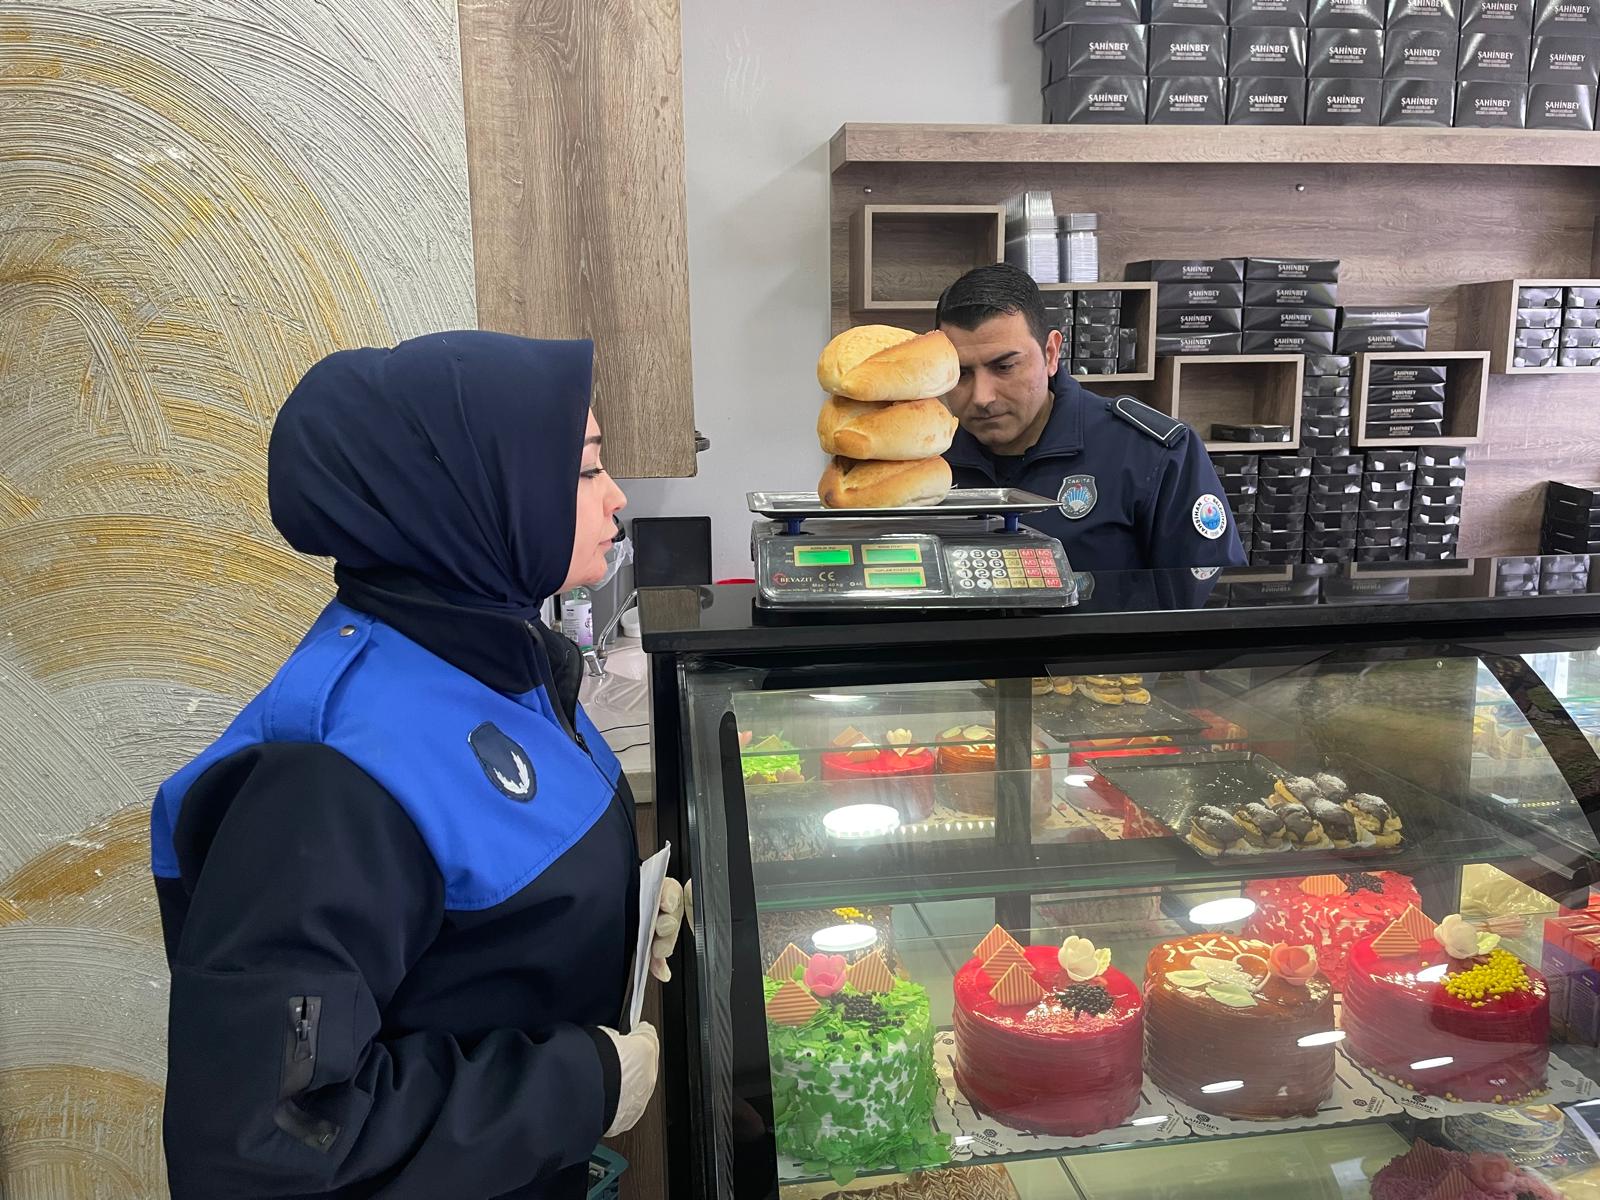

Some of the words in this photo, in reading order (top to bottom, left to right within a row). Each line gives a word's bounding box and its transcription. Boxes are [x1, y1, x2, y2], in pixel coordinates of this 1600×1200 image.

[1481, 1, 1519, 12] ŞAHİNBEY
[1554, 3, 1591, 14] ŞAHİNBEY
[1089, 40, 1129, 52] ŞAHİNBEY
[1170, 42, 1209, 53] ŞAHİNBEY
[1250, 43, 1289, 54] ŞAHİNBEY
[1329, 45, 1367, 56] ŞAHİNBEY
[1404, 47, 1441, 58] ŞAHİNBEY
[1477, 49, 1514, 60] ŞAHİNBEY
[1549, 52, 1586, 63] ŞAHİNBEY
[1088, 91, 1128, 103] ŞAHİNBEY
[1169, 93, 1208, 104] ŞAHİNBEY
[1249, 93, 1288, 104] ŞAHİNBEY
[1327, 94, 1365, 105] ŞAHİNBEY
[1401, 96, 1438, 107] ŞAHİNBEY
[1475, 97, 1511, 108] ŞAHİNBEY
[1545, 99, 1581, 110] ŞAHİNBEY
